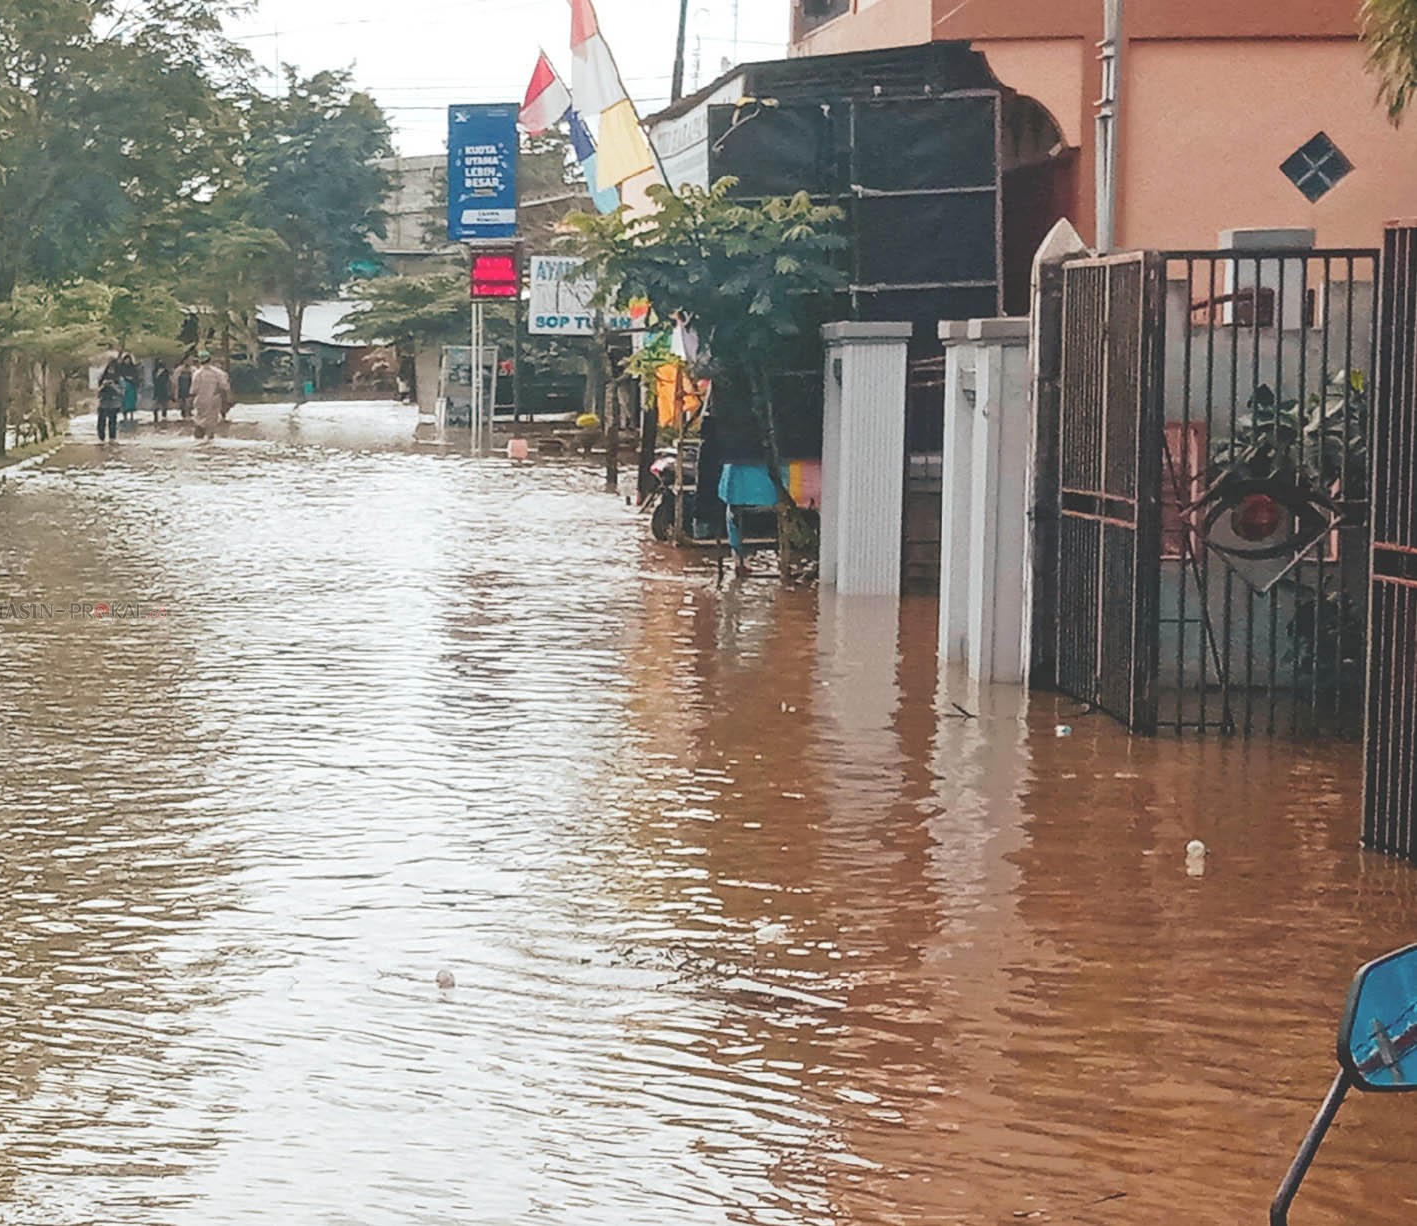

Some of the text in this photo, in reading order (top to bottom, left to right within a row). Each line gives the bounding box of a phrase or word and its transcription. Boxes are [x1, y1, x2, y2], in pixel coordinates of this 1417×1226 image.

[464, 145, 498, 155] KUOTA
[464, 155, 499, 165] UTAMA
[464, 166, 496, 177] LEBIH
[464, 176, 499, 187] BESAR
[536, 316, 570, 328] SOP
